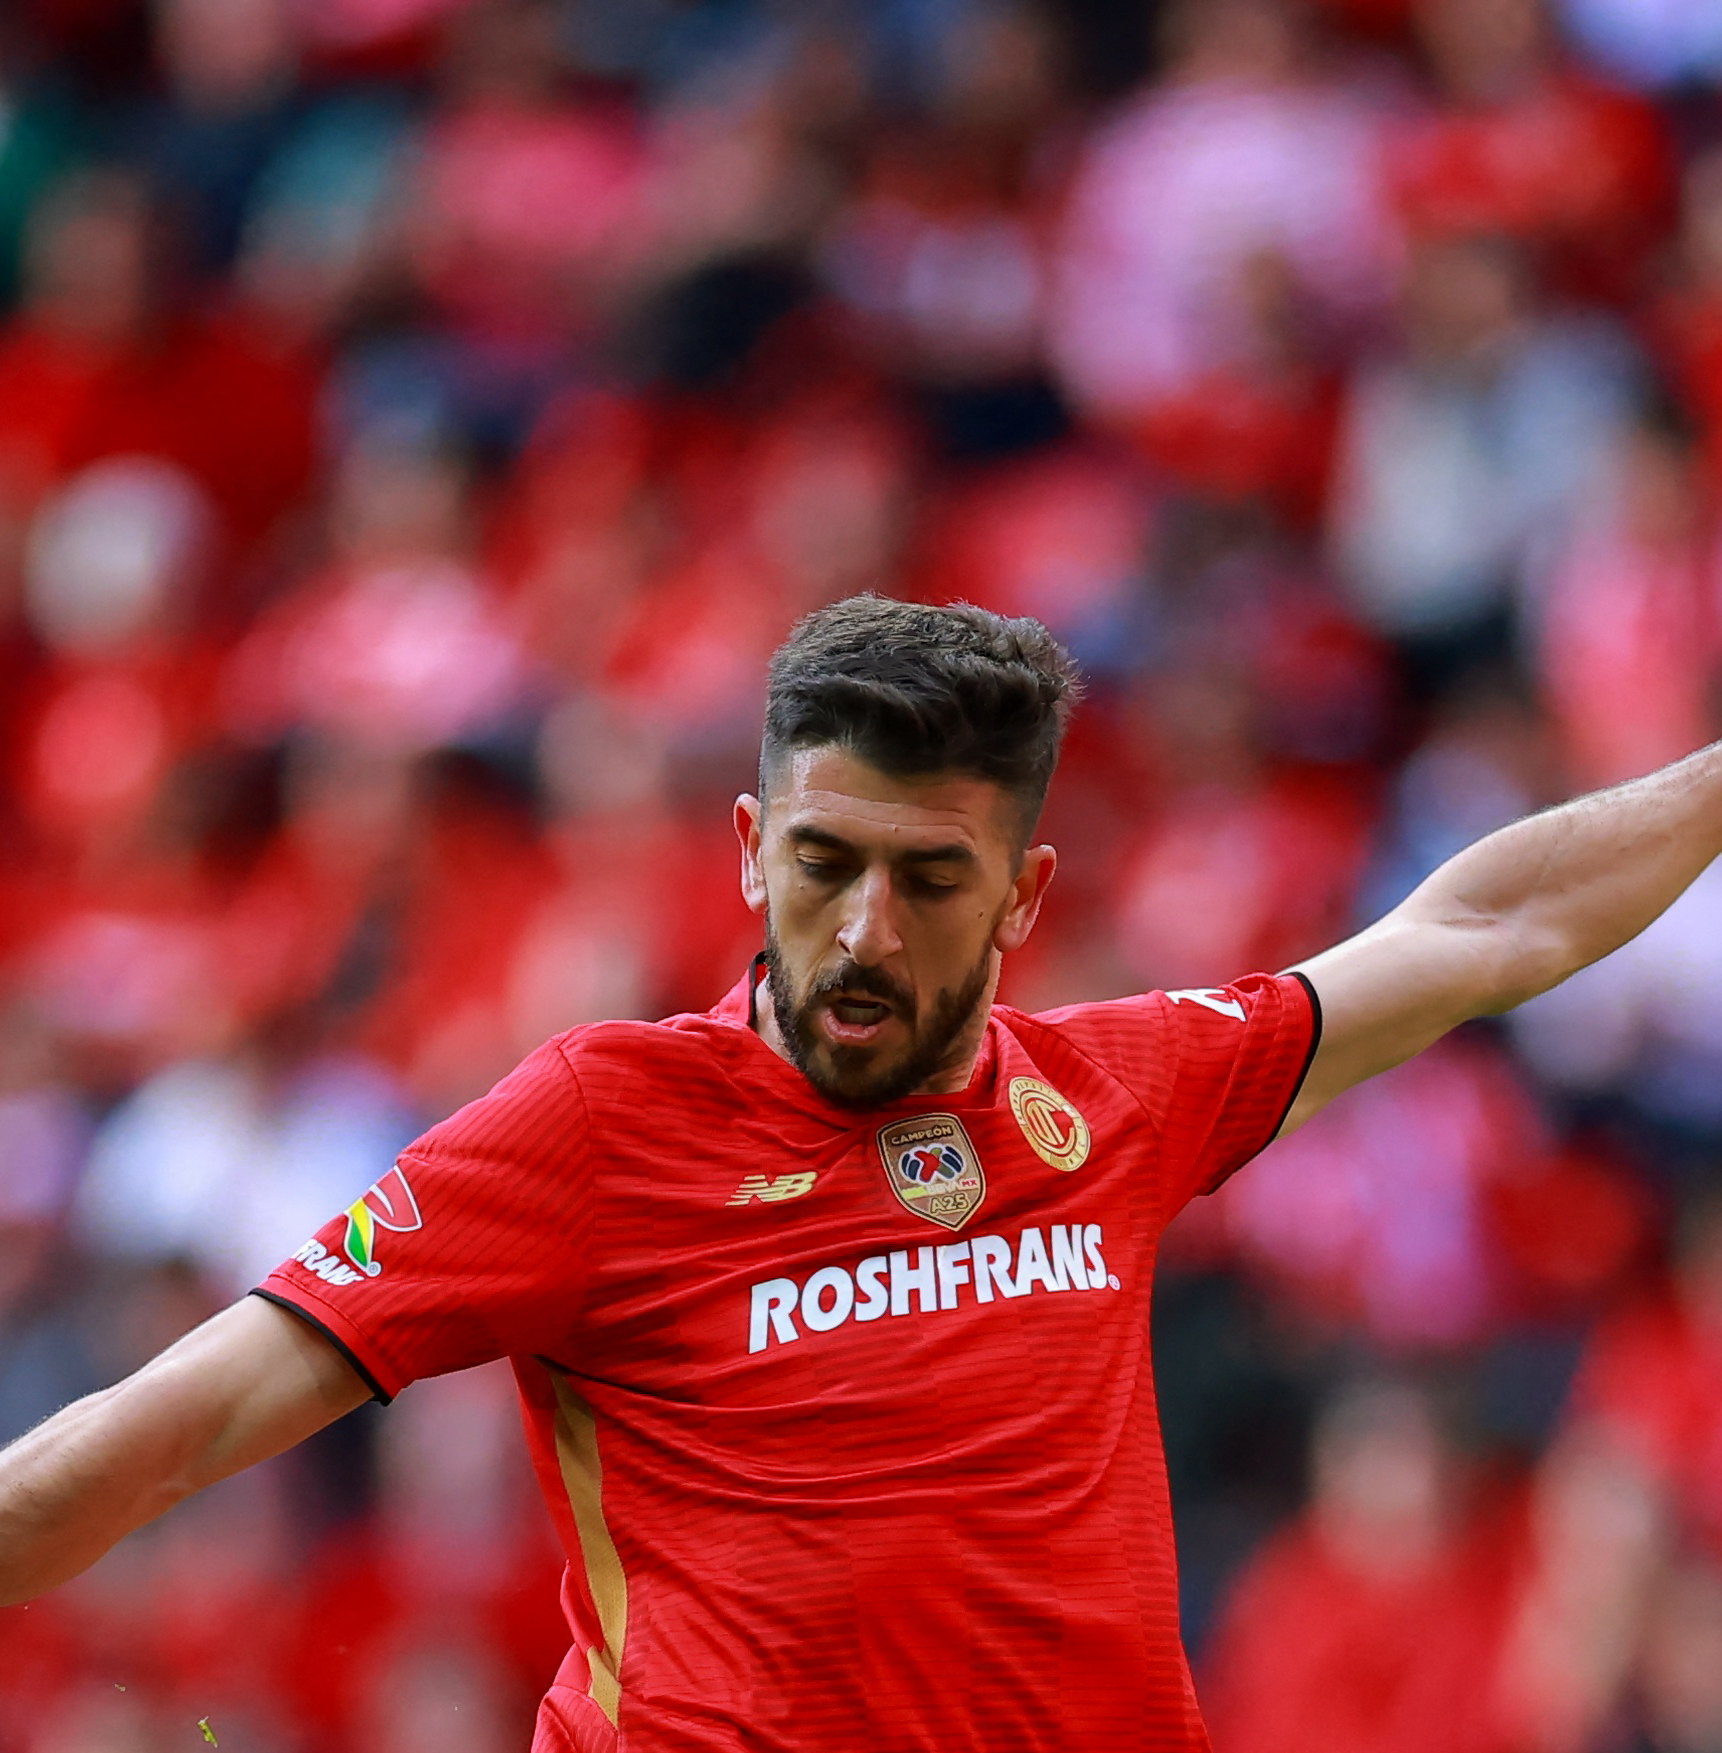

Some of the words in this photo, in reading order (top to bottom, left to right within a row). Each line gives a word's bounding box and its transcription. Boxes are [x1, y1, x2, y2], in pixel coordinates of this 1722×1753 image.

[890, 1125, 954, 1145] CAMPEÓN
[930, 1193, 968, 1214] A25
[749, 1224, 1107, 1354] ROSHFRANS
